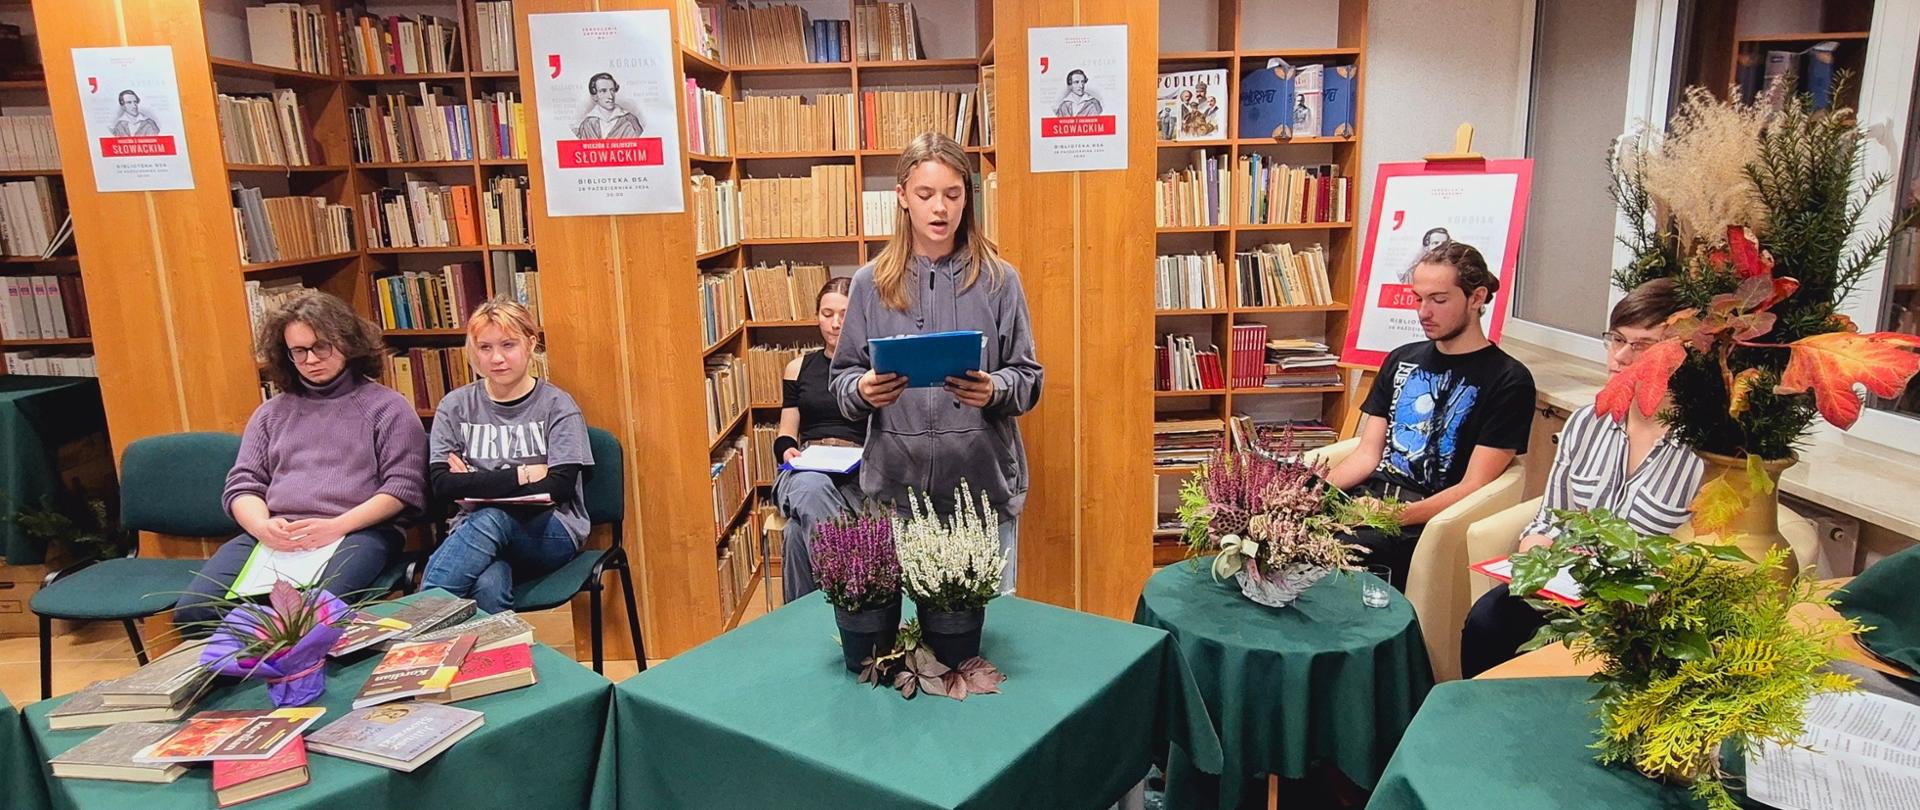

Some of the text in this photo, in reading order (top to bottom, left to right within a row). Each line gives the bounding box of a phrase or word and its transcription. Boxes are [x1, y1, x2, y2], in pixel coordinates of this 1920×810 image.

[1053, 123, 1104, 134] SŁOWACKIM
[112, 144, 165, 155] SŁOWACKIM
[575, 149, 647, 164] SŁOWACKIM
[578, 177, 628, 185] BIBLIOTEKA
[460, 421, 547, 460] NIRVAN
[374, 669, 429, 681] Kordian
